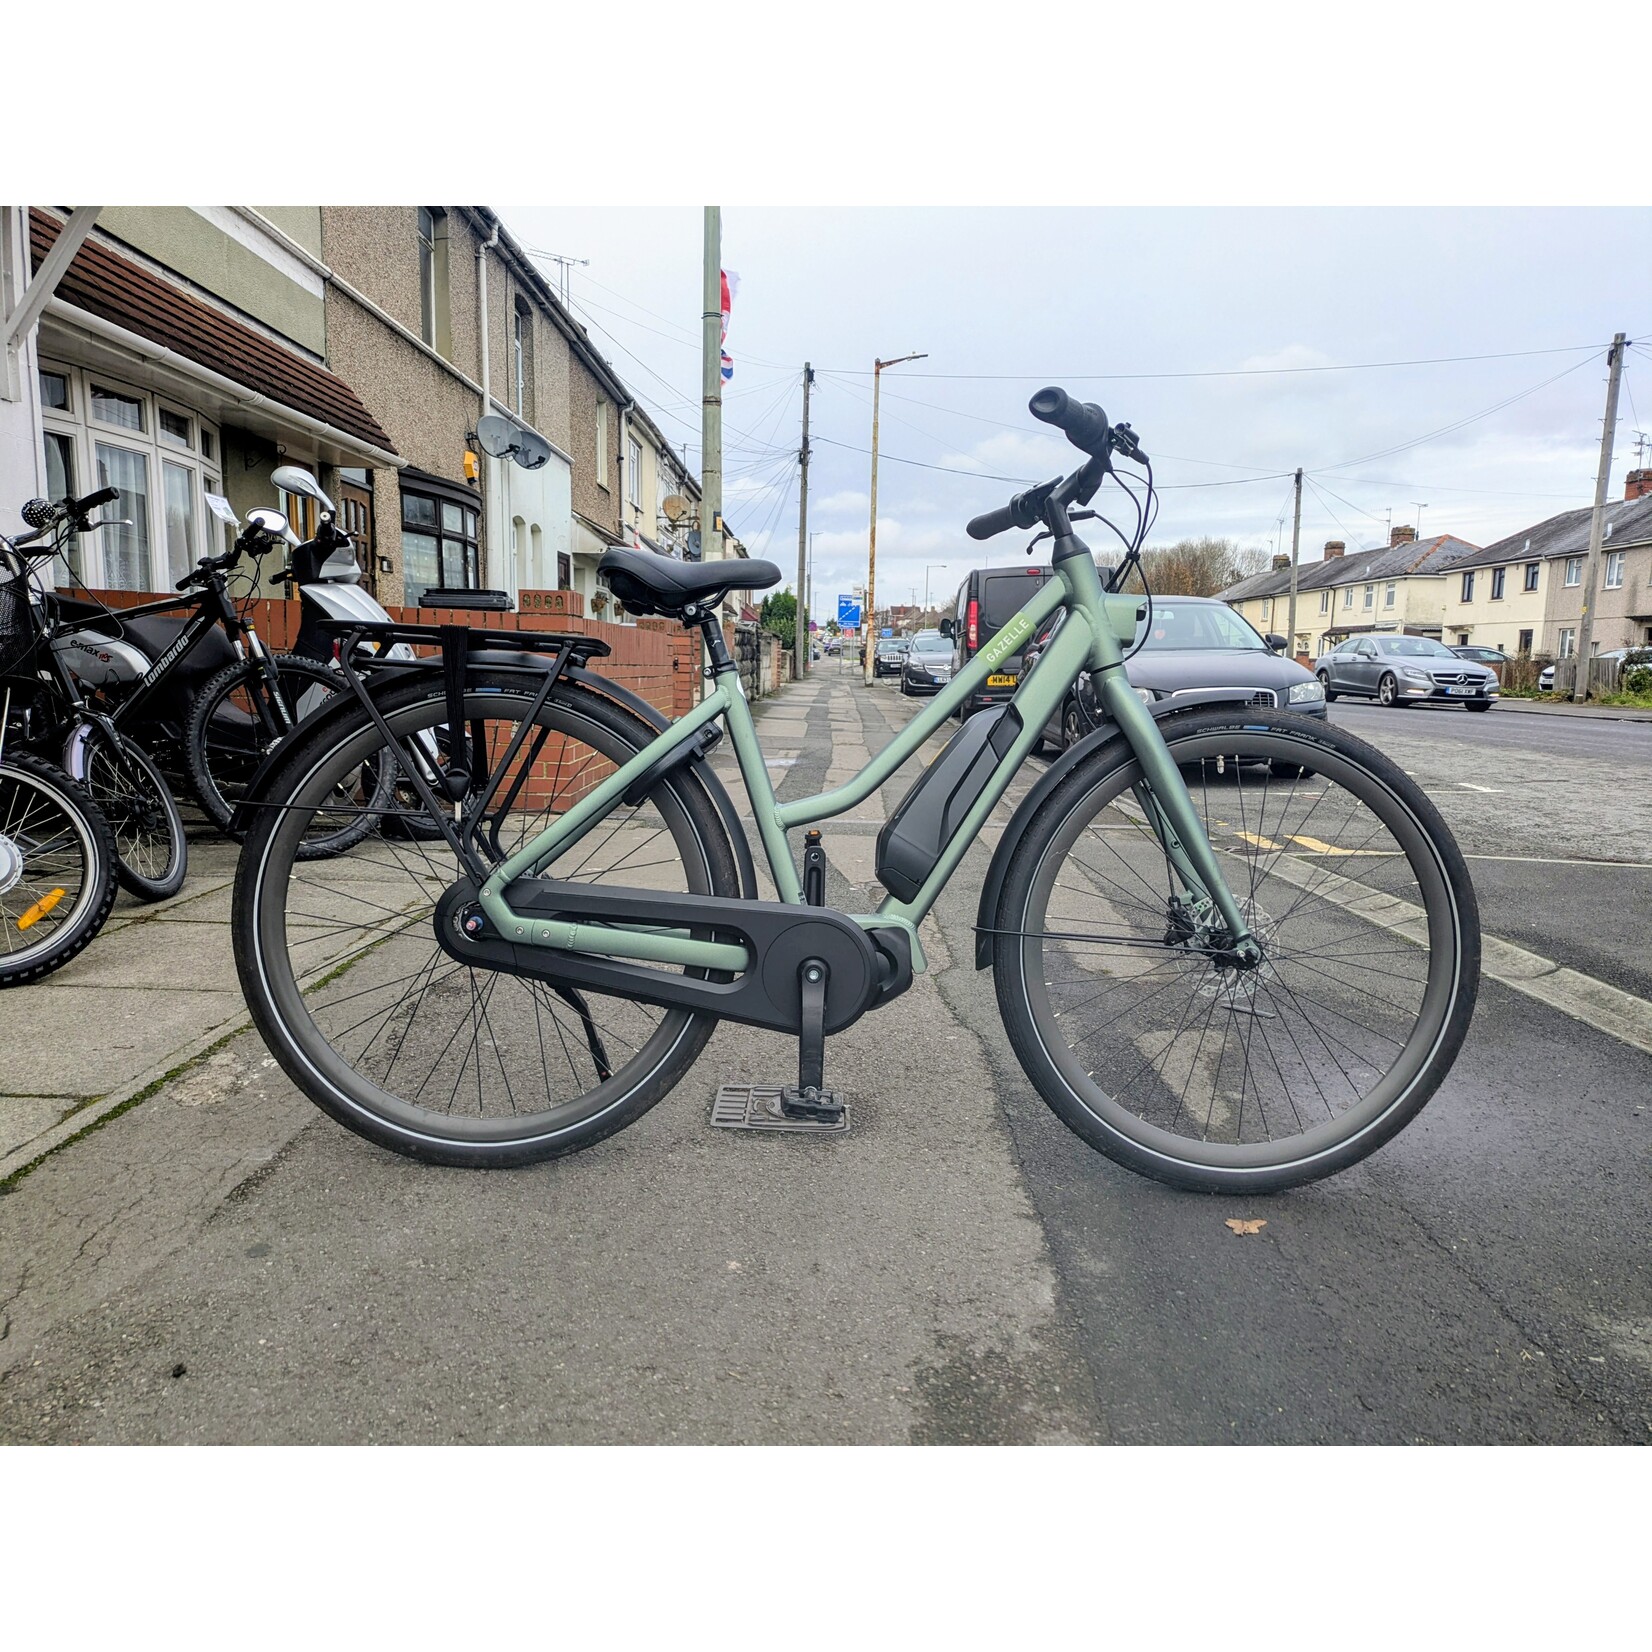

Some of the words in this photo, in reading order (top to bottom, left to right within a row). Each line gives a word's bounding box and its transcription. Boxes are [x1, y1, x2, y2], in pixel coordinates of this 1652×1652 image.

[986, 618, 1029, 662] GAZELLE
[1196, 724, 1241, 734] SCHWALBE
[1289, 730, 1317, 741] FRANK
